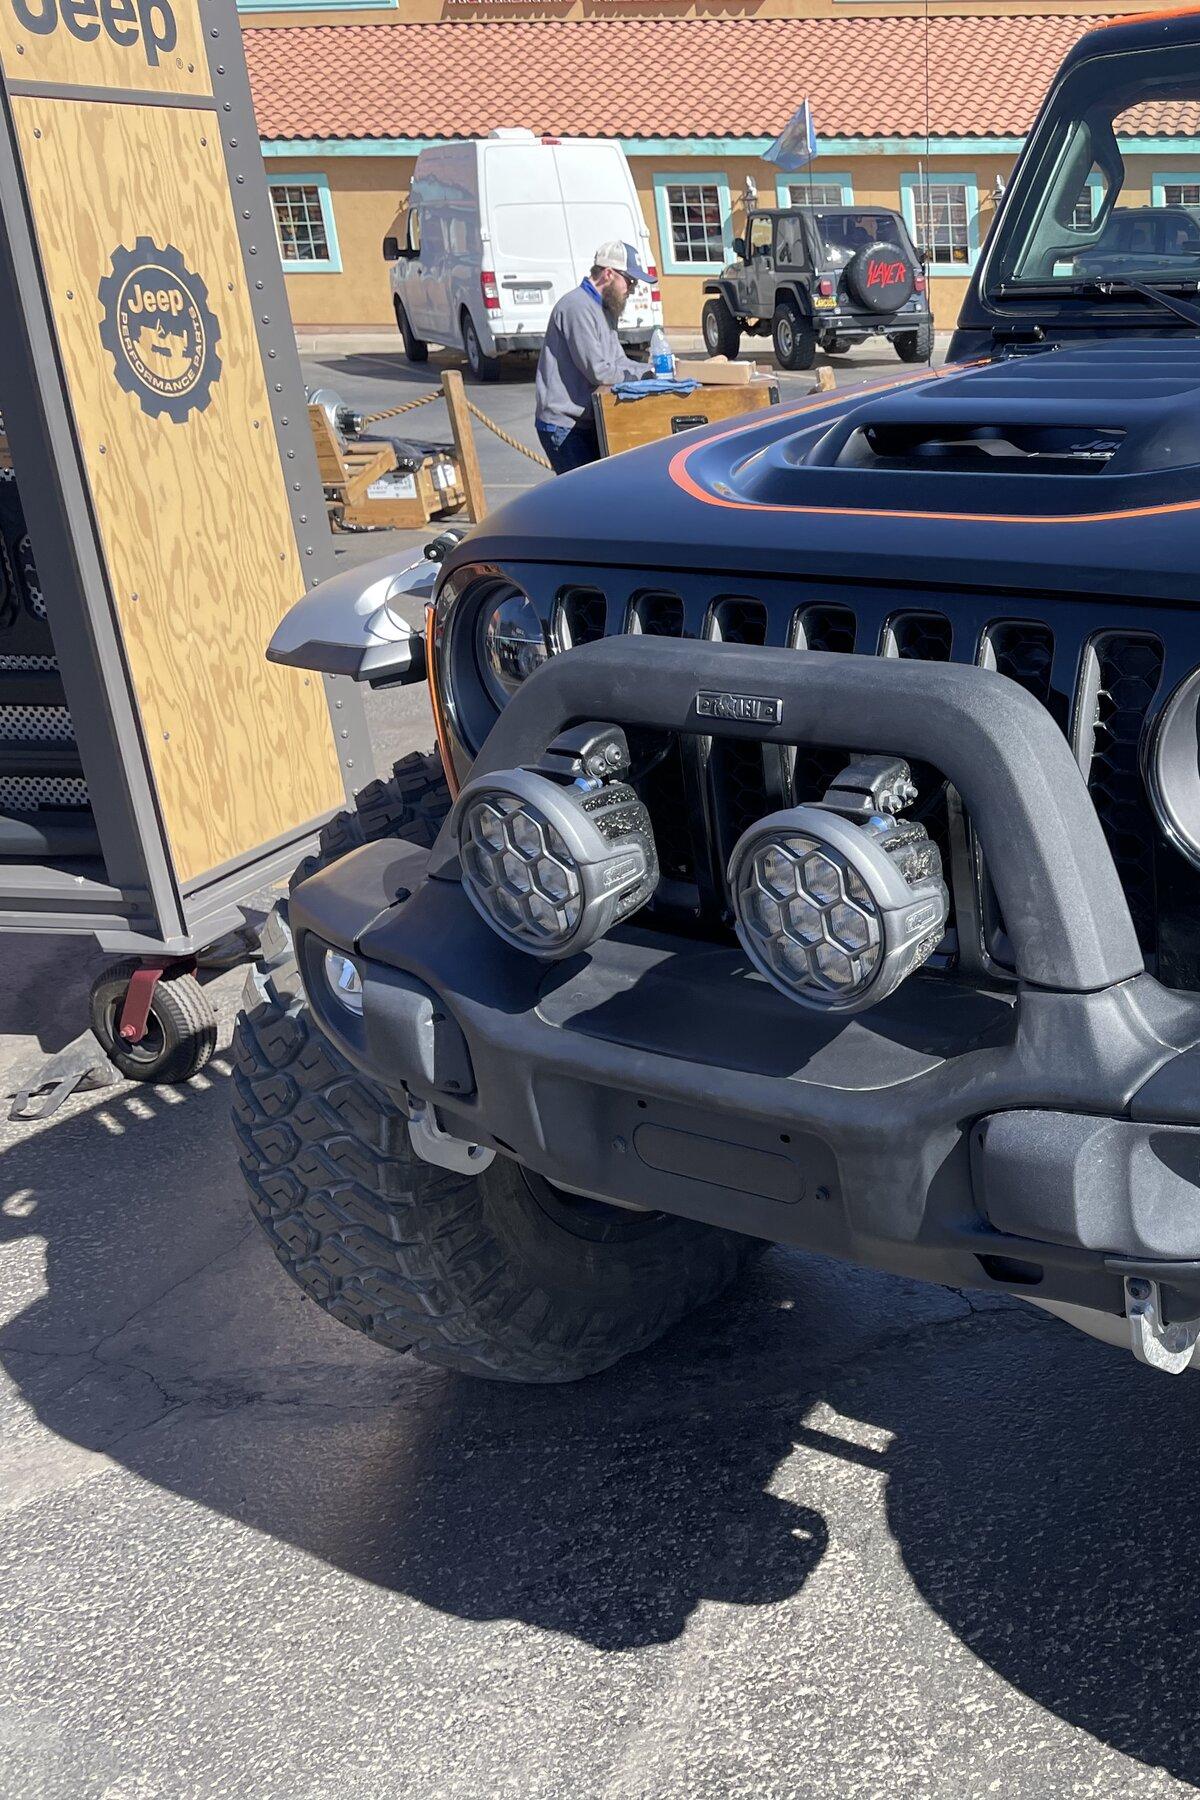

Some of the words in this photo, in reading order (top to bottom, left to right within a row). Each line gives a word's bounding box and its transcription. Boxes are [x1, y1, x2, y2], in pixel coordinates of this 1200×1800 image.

[11, 0, 178, 67] Jeep
[866, 259, 907, 289] SLAYER
[127, 283, 184, 316] Jeep
[120, 311, 197, 392] PERFORMANCE
[188, 306, 203, 367] PARTS
